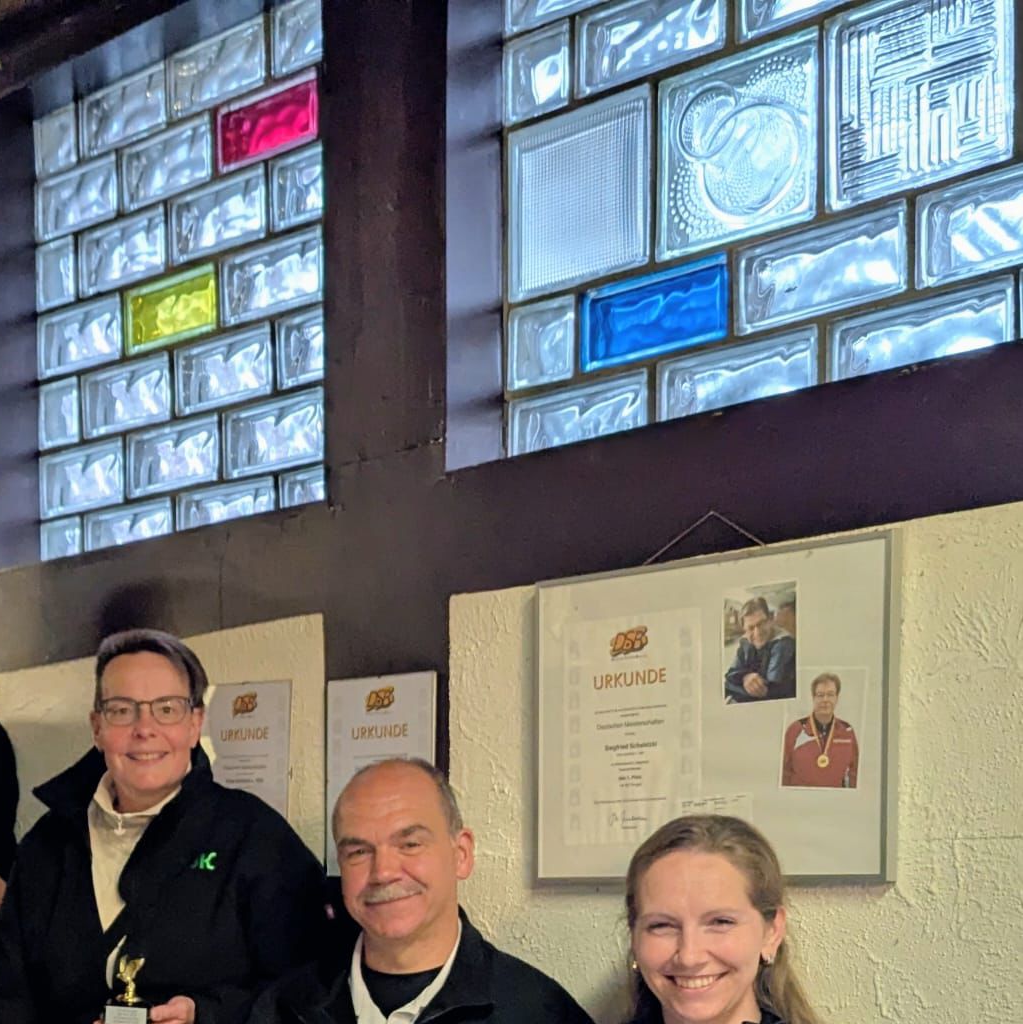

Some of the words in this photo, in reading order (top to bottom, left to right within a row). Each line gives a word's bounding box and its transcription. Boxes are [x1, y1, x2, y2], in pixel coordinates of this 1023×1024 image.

[593, 668, 667, 691] URKUNDE
[220, 726, 269, 742] URKUNDE
[351, 723, 409, 741] URKUNDE
